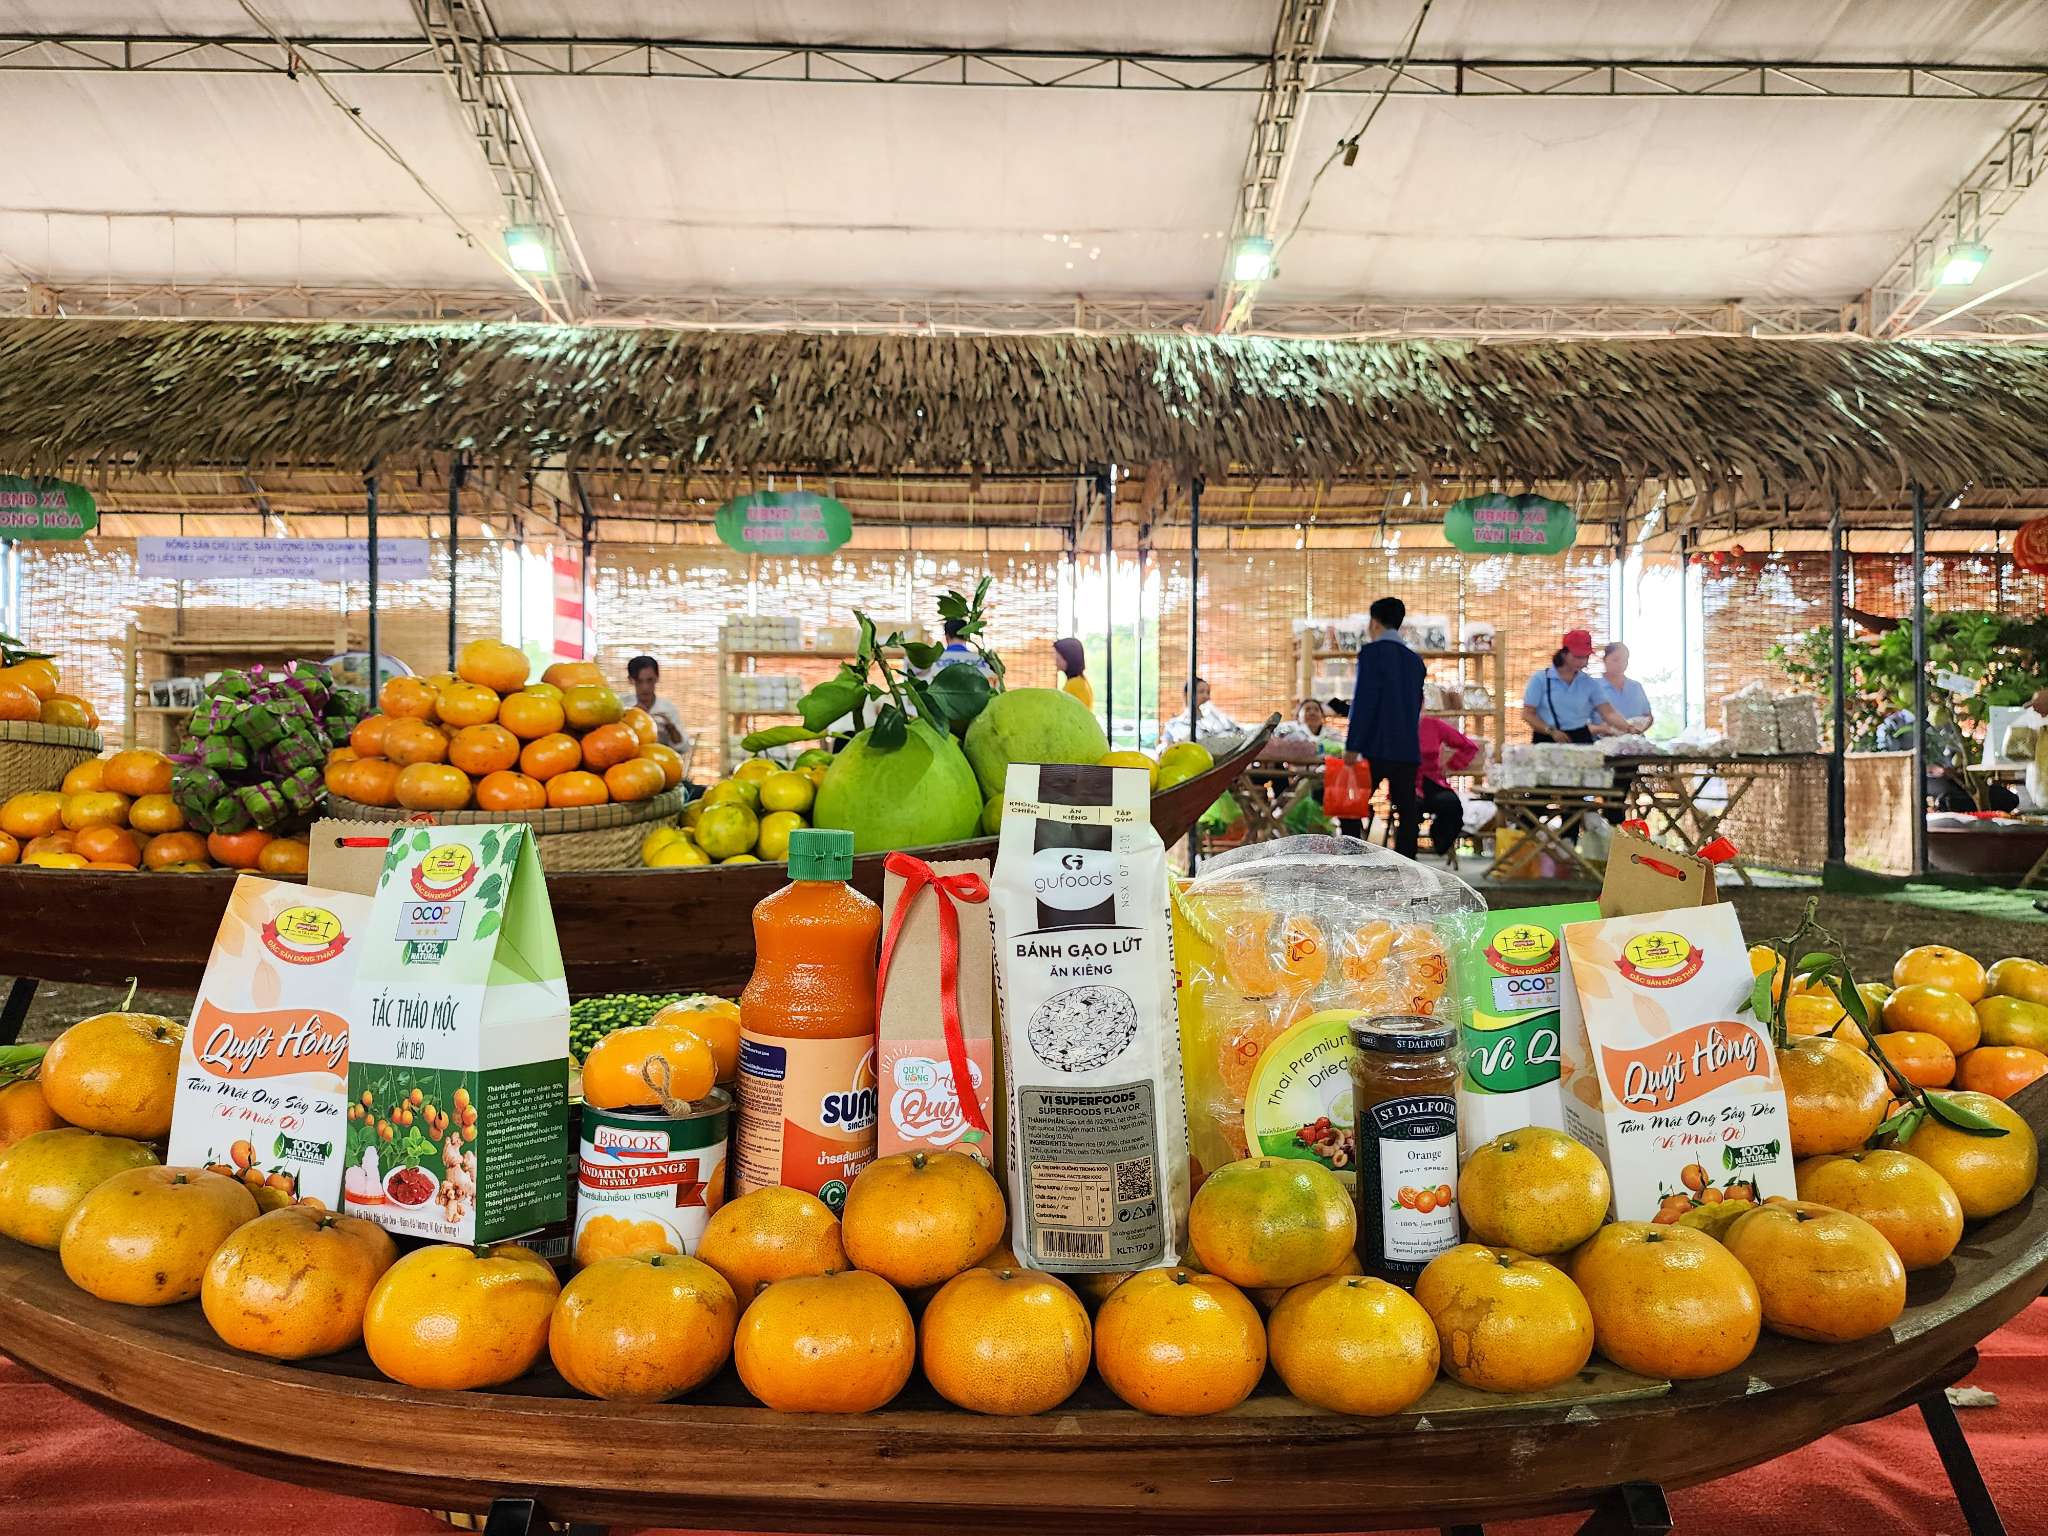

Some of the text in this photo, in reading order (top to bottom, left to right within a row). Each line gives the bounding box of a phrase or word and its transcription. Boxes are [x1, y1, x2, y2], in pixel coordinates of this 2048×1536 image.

[1034, 871, 1113, 893] gufoods
[412, 906, 451, 921] OCOP
[410, 952, 441, 960] NATURAL
[1016, 937, 1143, 960] BÁNH GẠO LỨT
[1050, 963, 1113, 977] ĂN KIÊNG
[1507, 977, 1555, 994] OCOP
[372, 986, 460, 1037] TẮC THẢO MỘC
[200, 1014, 349, 1073] Quýt Hồng
[1408, 1037, 1445, 1049] DALFOUR
[1524, 1028, 1560, 1065] Q
[1622, 1026, 1759, 1107] Quýt Hồng
[1268, 1072, 1293, 1105] Thai
[252, 1089, 280, 1109] Ong
[285, 1096, 309, 1115] Sấy
[1040, 1092, 1136, 1107] VỊ SUPERFOODS
[1038, 1103, 1141, 1116] SUPERFOODS FLAVOR
[1396, 1101, 1456, 1117] DALFOUR
[1687, 1110, 1716, 1127] Ong
[1720, 1105, 1745, 1123] Sấy
[847, 1119, 865, 1131] SINCE
[1413, 1125, 1435, 1135] FRANCE
[292, 1139, 320, 1153] 100%
[599, 1130, 663, 1151] BROOK
[285, 1147, 326, 1162] NATURAL
[1407, 1150, 1442, 1163] Orange
[1739, 1145, 1769, 1158] 100%
[1735, 1153, 1776, 1166] NATURAL
[629, 1162, 687, 1178] ORANGE
[600, 1178, 638, 1187] IN SYRUP
[1116, 1246, 1134, 1255] KLT:
[1135, 1243, 1148, 1252] 170
